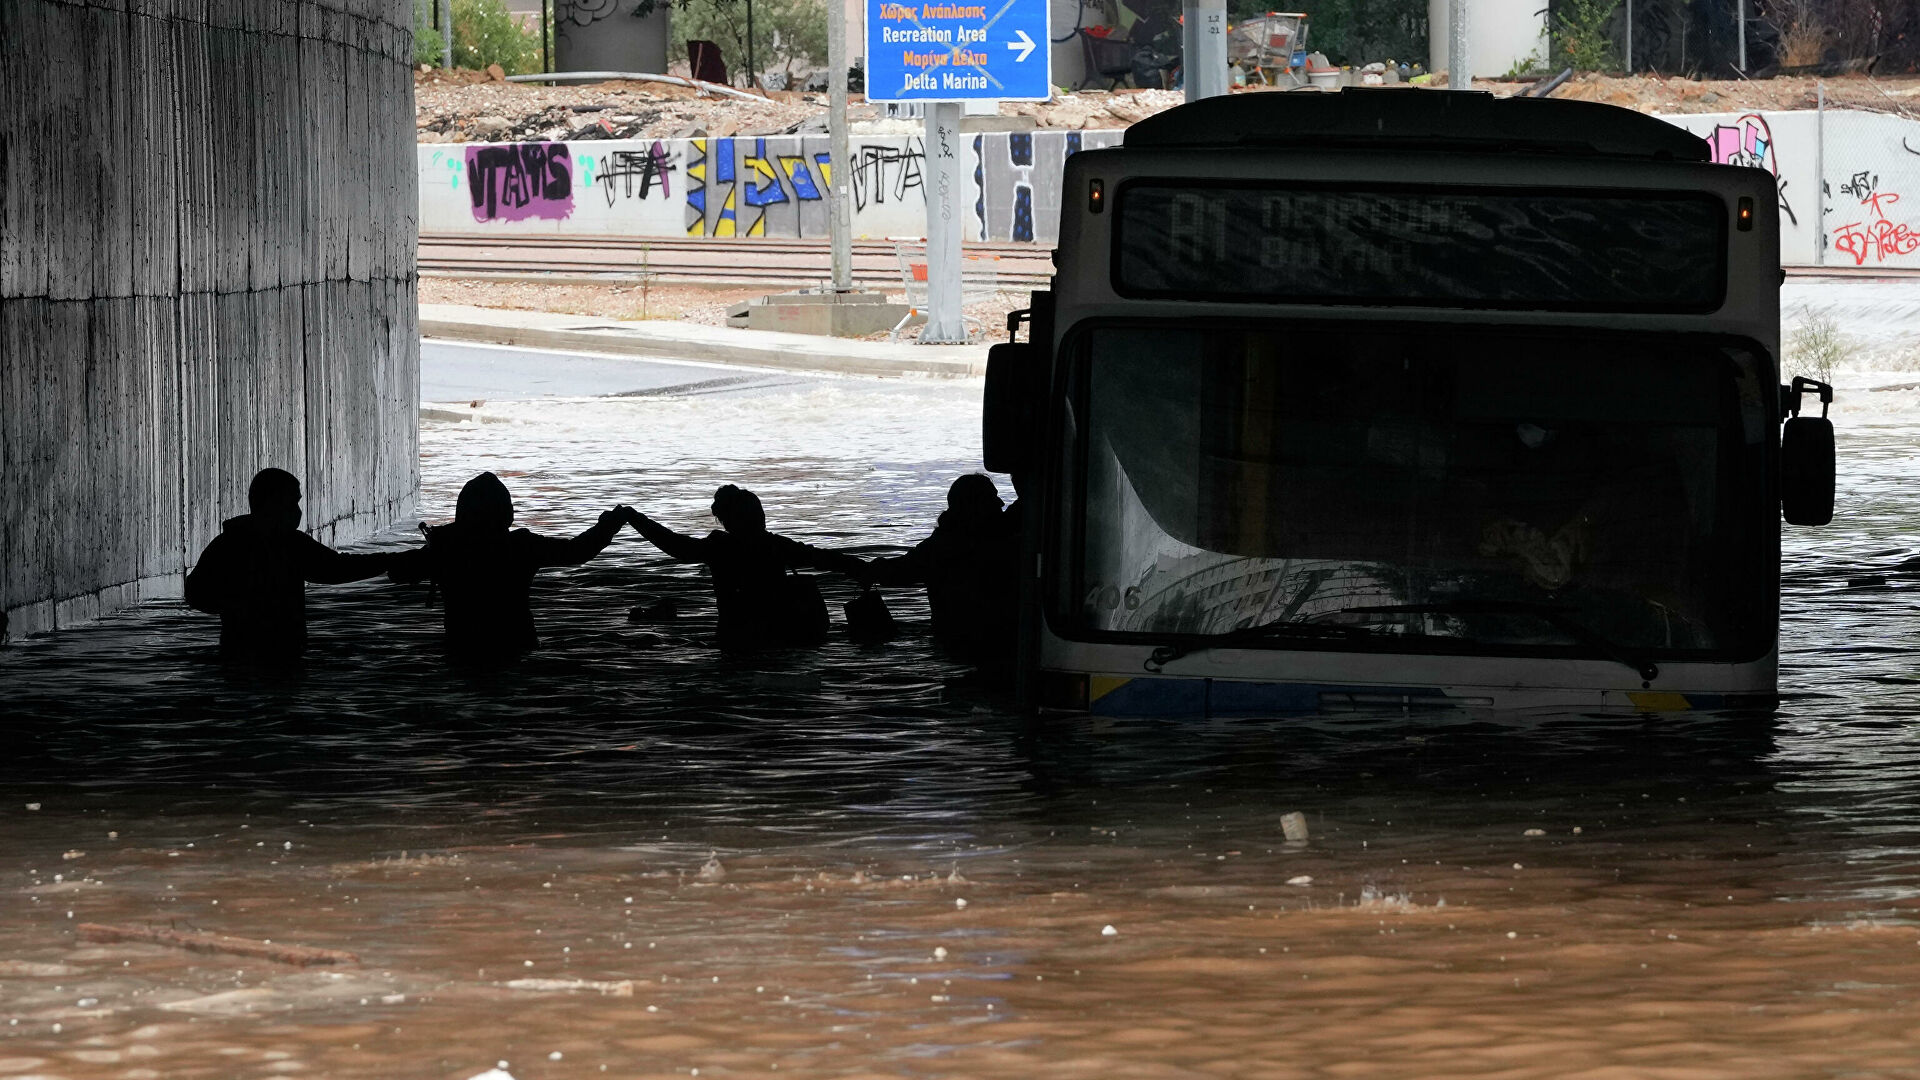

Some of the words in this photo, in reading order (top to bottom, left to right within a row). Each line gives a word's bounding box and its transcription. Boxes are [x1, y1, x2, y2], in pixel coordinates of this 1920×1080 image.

[880, 3, 917, 23] Χώρος
[922, 3, 986, 21] Ανάπλασης
[883, 26, 952, 43] Recreation
[957, 25, 987, 42] Area
[903, 51, 948, 70] Μαρίνα
[952, 49, 987, 66] Δέλτα
[904, 73, 937, 90] Delta
[943, 72, 987, 90] Marina
